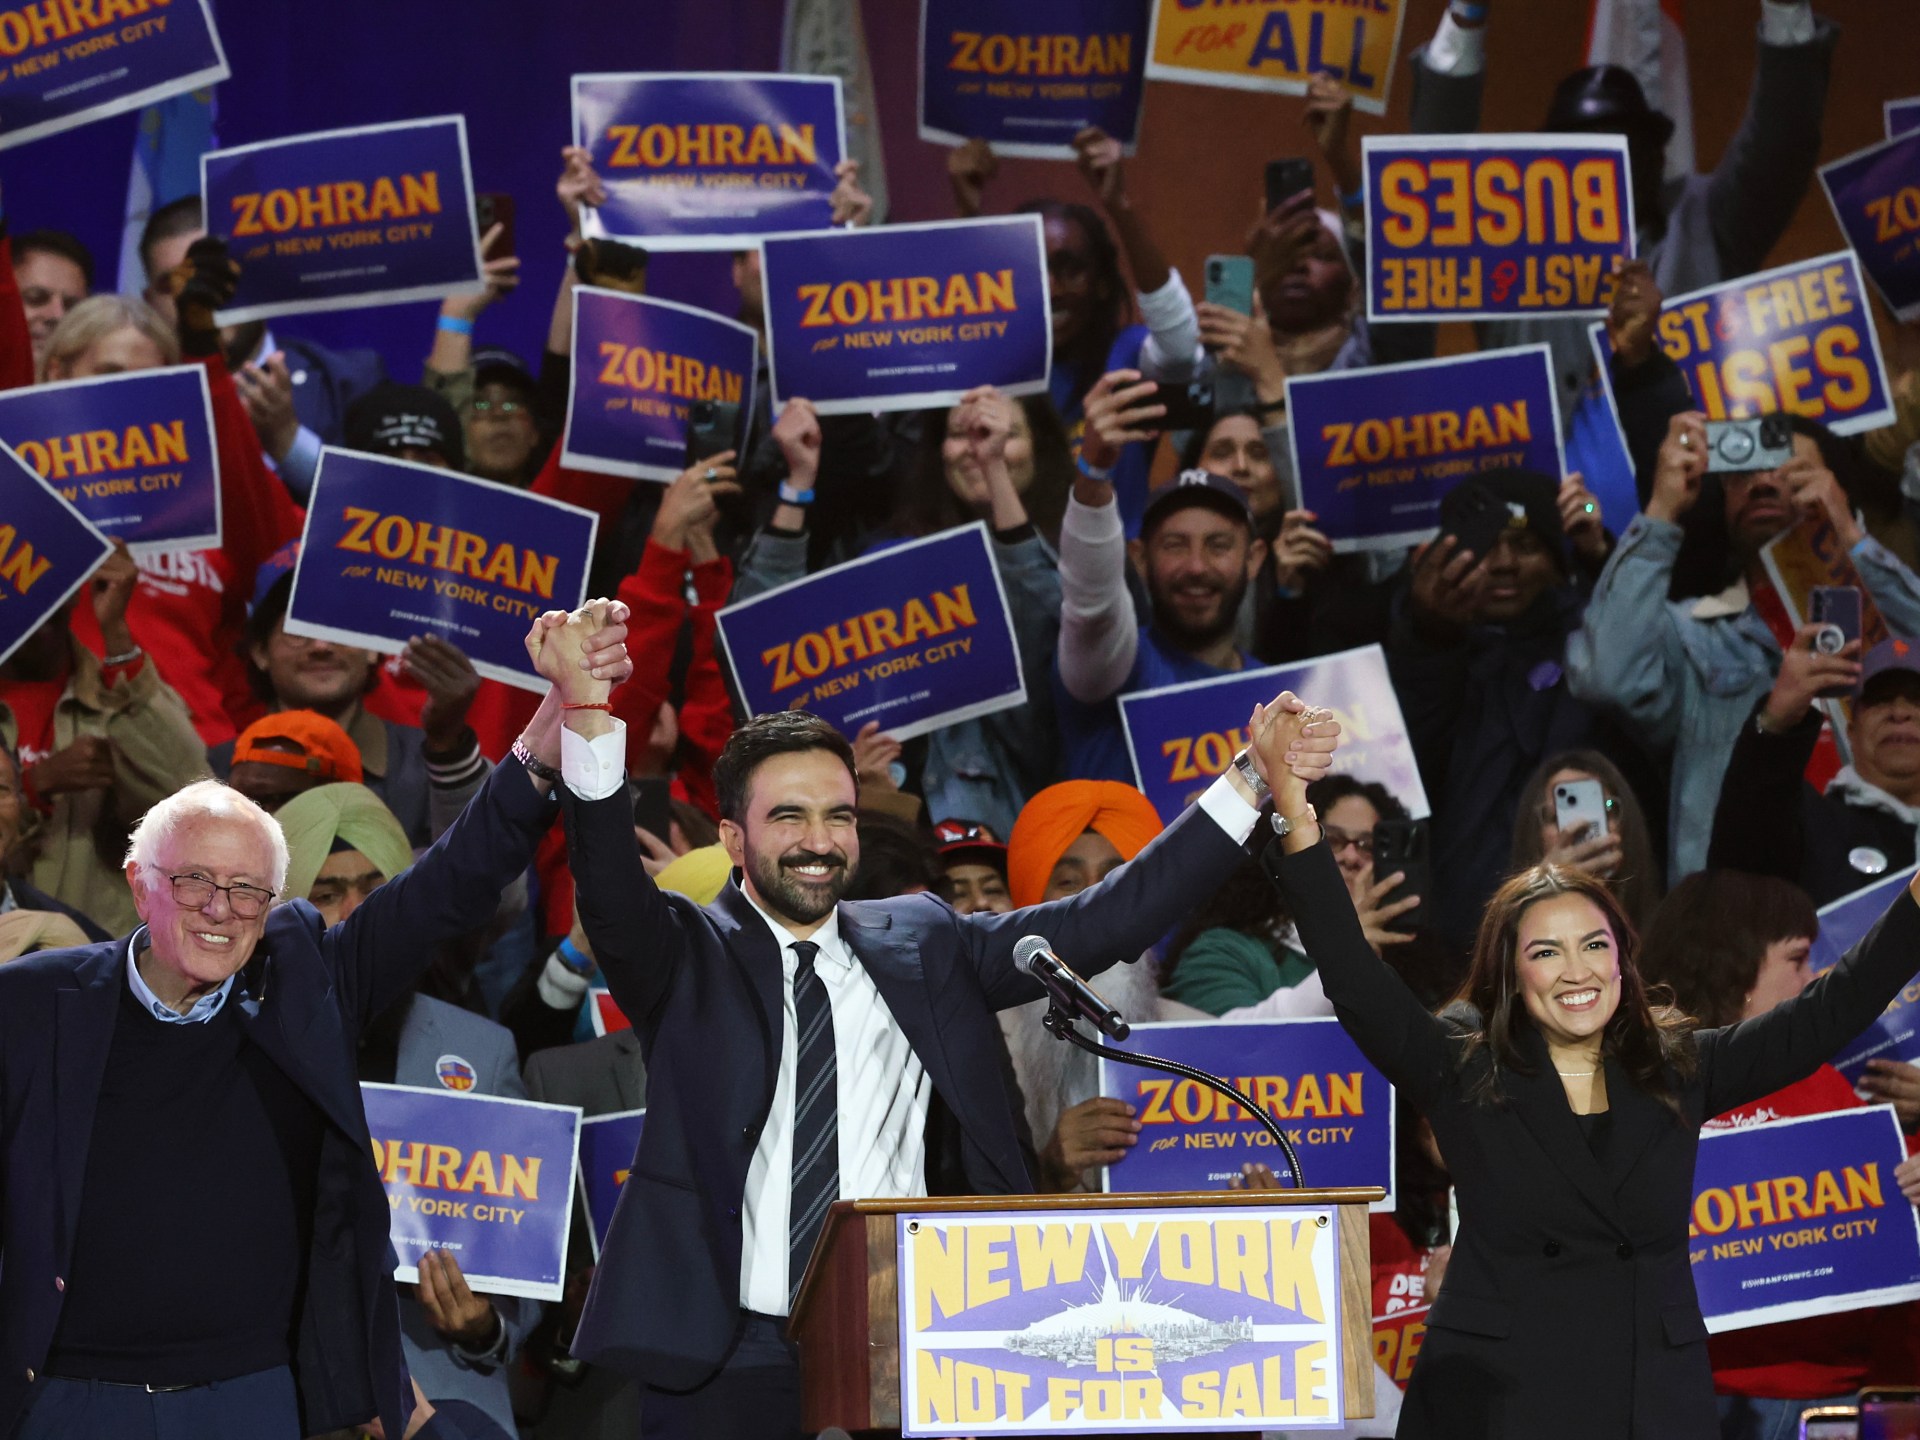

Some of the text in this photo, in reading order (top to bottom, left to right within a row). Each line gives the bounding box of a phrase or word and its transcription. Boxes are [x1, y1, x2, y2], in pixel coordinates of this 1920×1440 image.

[0, 0, 172, 56] OHR
[12, 15, 167, 79] NEW YORK CITY
[947, 31, 1132, 76] ZOHRAN
[1173, 10, 1376, 90] FOR ALL
[607, 123, 817, 167] ZOHRAN
[231, 171, 442, 237] ZOHRAN
[760, 172, 808, 188] CITY
[1380, 156, 1622, 248] BUSES
[275, 236, 323, 256] NEW
[328, 229, 382, 248] YORK
[386, 223, 433, 243] CITY
[796, 267, 1018, 328] ZOHRAN
[1381, 256, 1483, 310] FREE
[1518, 254, 1624, 307] FAST
[844, 331, 893, 349] NEW
[898, 324, 954, 345] YORK
[958, 320, 1008, 341] CITY
[1654, 301, 1712, 361] ST
[1744, 264, 1853, 337] FREE
[599, 341, 744, 404] ZOHRAN
[1322, 399, 1532, 467] ZOHRAN
[82, 477, 138, 500] YORK
[140, 471, 183, 493] CITY
[1367, 468, 1416, 486] NEW
[1421, 458, 1475, 479] YORK
[336, 506, 560, 599] ZOHRAN
[375, 567, 428, 591] NEW
[433, 579, 489, 606] YORK
[492, 595, 540, 621] CITY
[761, 583, 978, 693] ZOHRAN
[813, 671, 859, 701] NEW
[864, 652, 922, 682] YORK
[924, 637, 973, 664] CITY
[1138, 1072, 1365, 1125] ZOHRAN
[1150, 1127, 1354, 1153] FOR NEW YOK CITY
[410, 1197, 468, 1219] YORK
[472, 1204, 524, 1225] CITY
[1689, 1162, 1885, 1237] OHRAN
[1712, 1235, 1763, 1260] NEW
[1768, 1226, 1828, 1250] YORK
[1832, 1219, 1878, 1240] CITY
[913, 1219, 1326, 1332] NEW YORK
[916, 1341, 1329, 1424] NOT FOR SALE
[1096, 1338, 1153, 1372] IS
